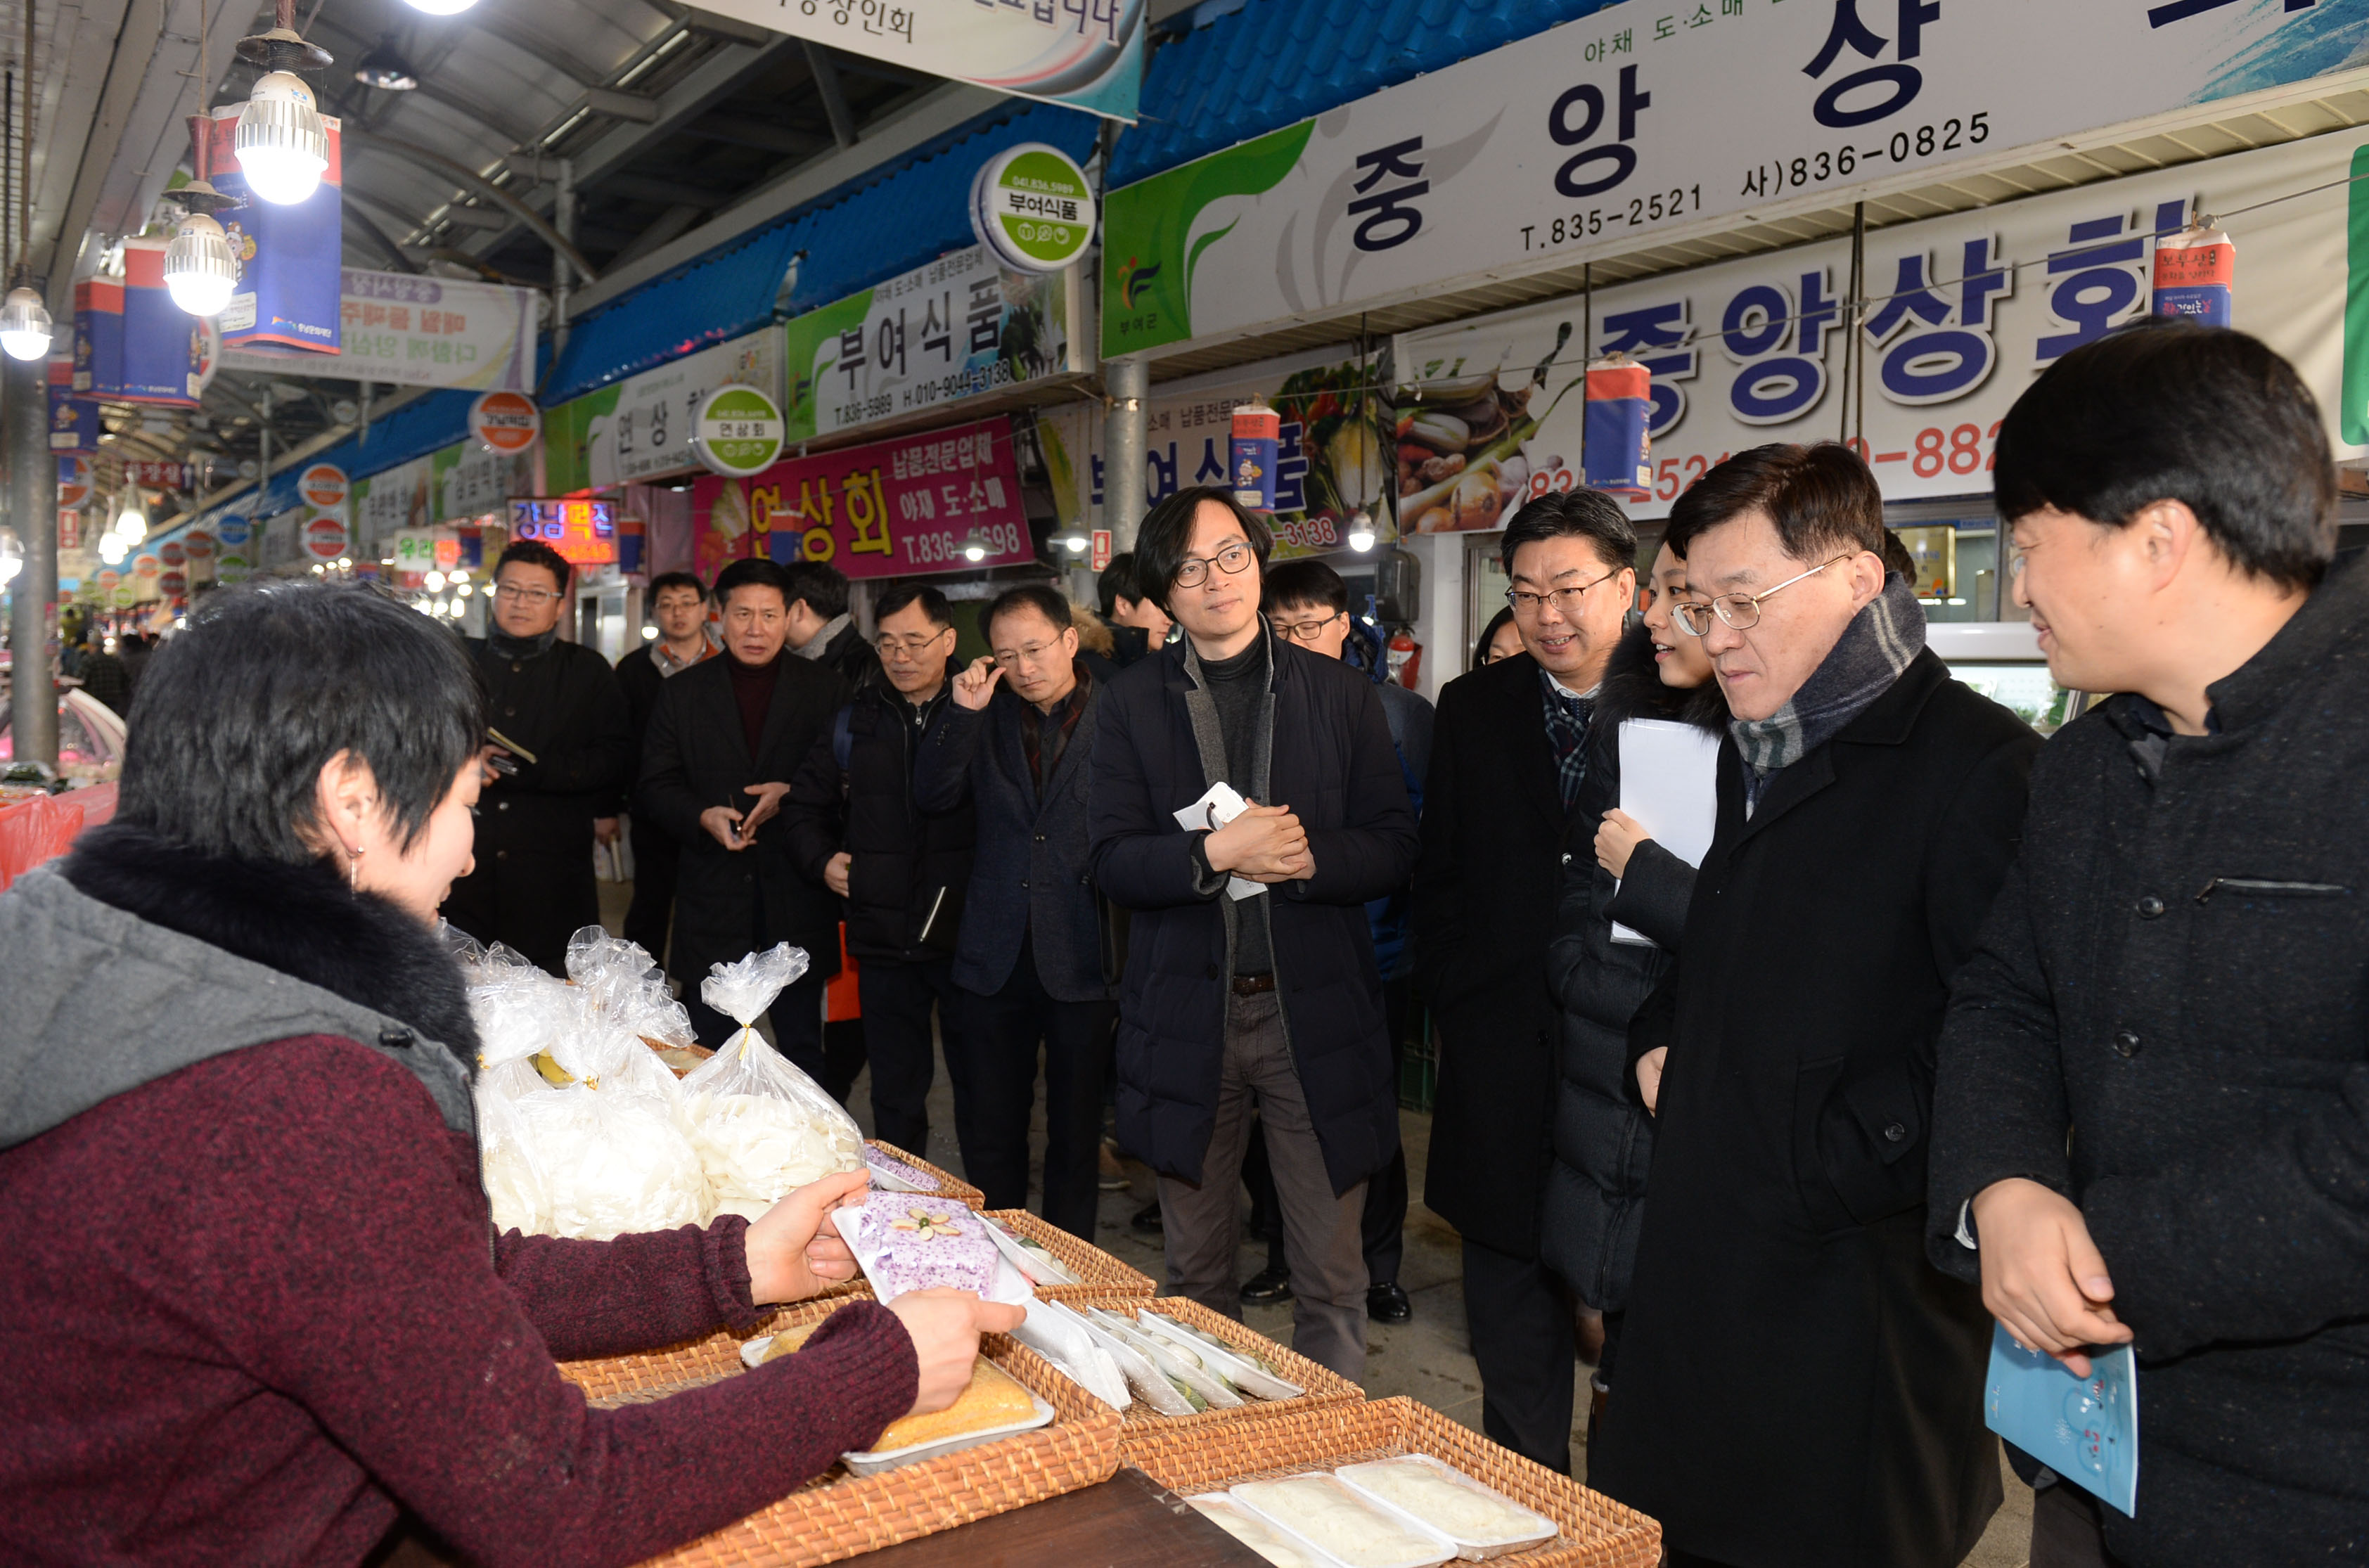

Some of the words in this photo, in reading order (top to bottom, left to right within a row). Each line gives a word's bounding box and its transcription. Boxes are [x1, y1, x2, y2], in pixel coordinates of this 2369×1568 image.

[1584, 28, 1633, 62] 야채
[1009, 193, 1077, 221] 부여식품
[1521, 183, 1703, 252] T.835-2521
[720, 423, 766, 438] 연상회
[892, 430, 994, 481] 납품전문업체
[899, 488, 936, 522] 야채
[941, 476, 1008, 518] 도·소매
[514, 503, 616, 541] 강남떡집
